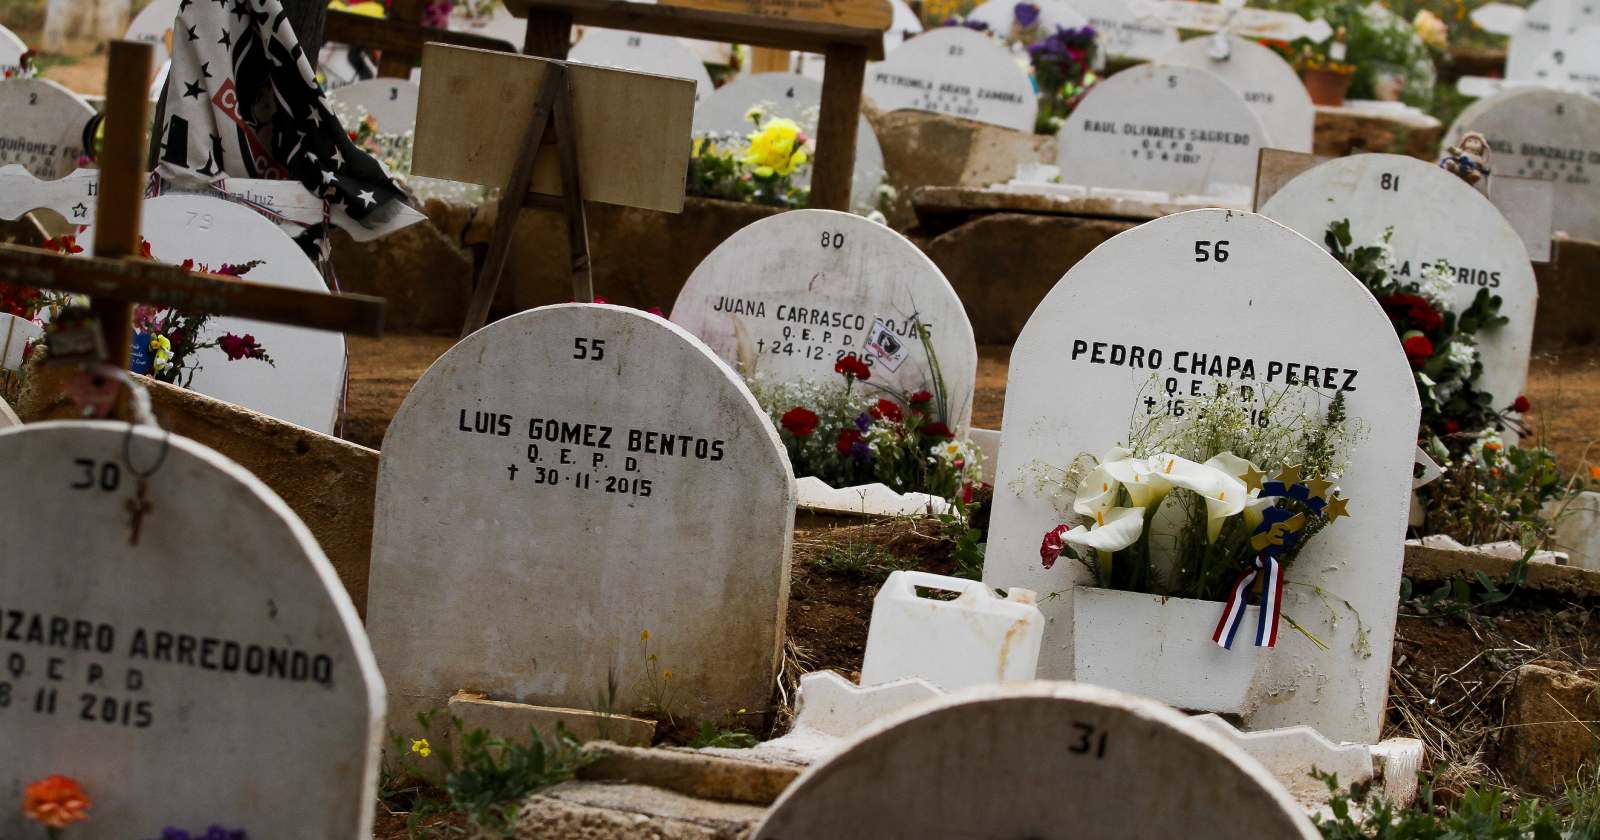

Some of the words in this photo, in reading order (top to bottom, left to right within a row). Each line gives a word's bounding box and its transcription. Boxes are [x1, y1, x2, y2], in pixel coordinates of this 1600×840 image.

[1168, 75, 1178, 88] 5
[29, 92, 38, 105] 2
[1084, 119, 1117, 134] RAUL
[1123, 123, 1186, 140] OLIVARES
[1190, 129, 1249, 146] SAGREDO
[1380, 172, 1399, 192] 81
[820, 231, 844, 249] 80
[1194, 240, 1230, 263] 56
[713, 296, 766, 318] JUANA
[776, 304, 865, 331] CARRASCO
[876, 317, 932, 340] OJAS
[573, 337, 605, 361] 55
[1072, 339, 1163, 369] PEDRO
[1173, 351, 1256, 380] CHAPA
[1266, 361, 1359, 391] PEREZ
[459, 409, 513, 436] LUIS
[528, 418, 613, 449] GOMEZ
[627, 429, 725, 461] BENTOS
[70, 458, 121, 492] 30
[129, 628, 334, 688] ARREDONDO
[1068, 721, 1109, 758] 31
